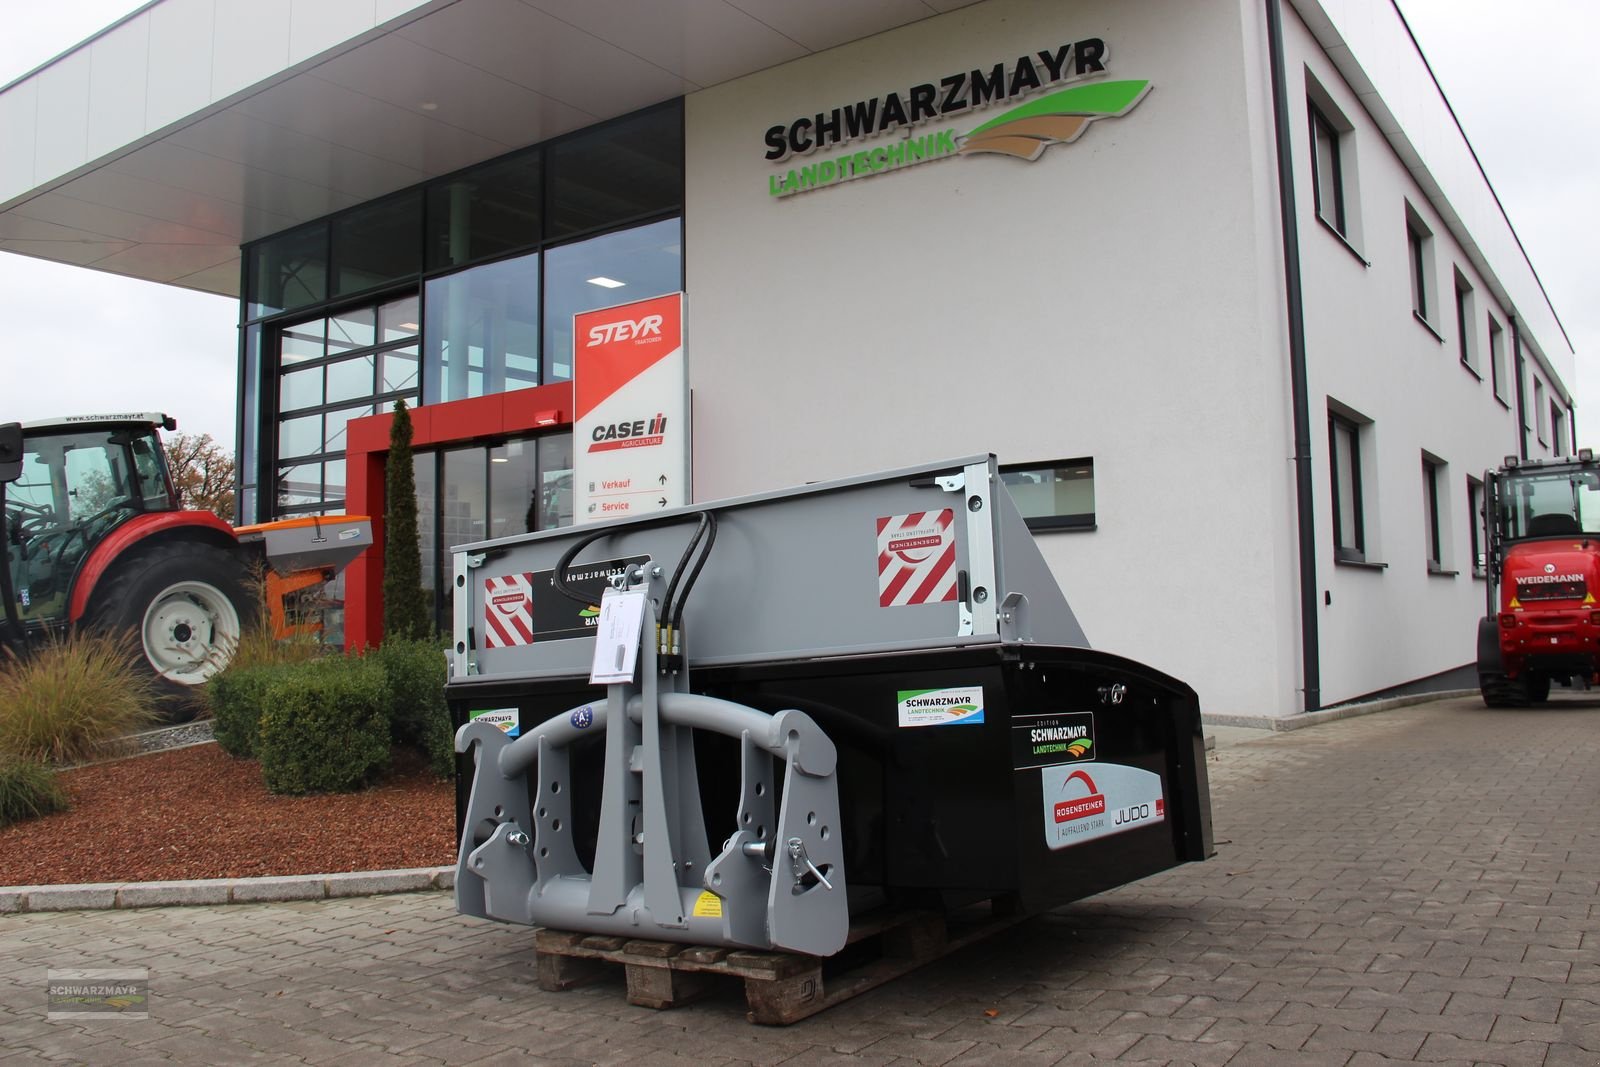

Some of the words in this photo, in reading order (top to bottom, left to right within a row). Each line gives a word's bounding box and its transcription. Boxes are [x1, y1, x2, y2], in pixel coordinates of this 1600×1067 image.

[765, 37, 1109, 160] SCHWARZMAYR
[769, 127, 957, 197] LANDTECHNIK
[587, 314, 663, 347] STEYR
[634, 336, 662, 346] TRAKTOREN
[65, 413, 145, 423] www.schwarzmayr.at
[592, 420, 645, 442] CASE
[621, 438, 662, 448] AGRICULTURE
[601, 479, 631, 490] Verkauf
[602, 502, 630, 512] Service
[890, 538, 940, 550] ROSENSTEINER
[1515, 574, 1584, 585] WEIDEMANN
[906, 696, 971, 707] SCHWARZMAYR
[1036, 719, 1059, 727] EDITION
[1030, 725, 1087, 743] SCHWARZMAYR
[1032, 743, 1068, 755] LANDTECHNIK
[1056, 799, 1104, 817] ROSENSTEINER
[1115, 803, 1149, 825] JUDO
[1061, 822, 1090, 836] AUFFALLEND
[1091, 819, 1105, 830] STARK
